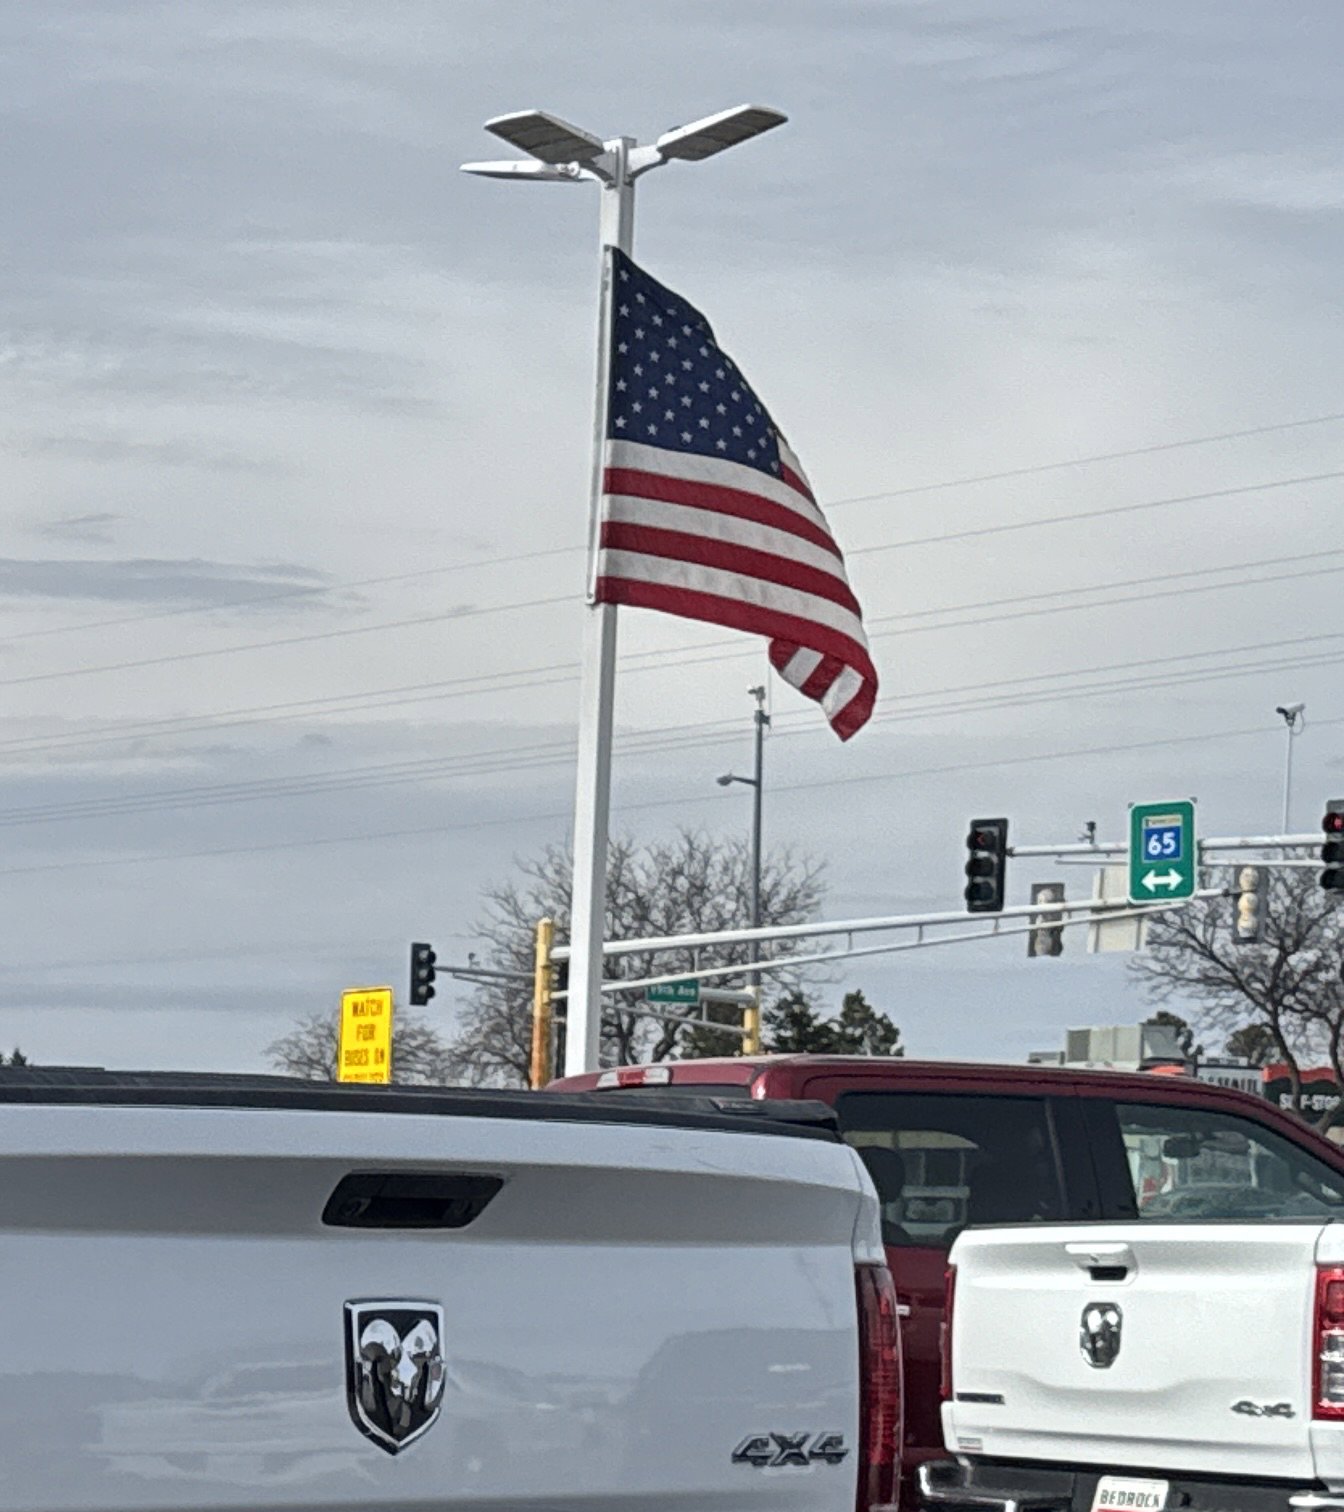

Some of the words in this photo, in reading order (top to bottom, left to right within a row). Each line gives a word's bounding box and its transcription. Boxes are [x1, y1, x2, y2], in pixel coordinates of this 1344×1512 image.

[1147, 831, 1177, 856] 65
[351, 998, 385, 1017] WATCH
[355, 1023, 377, 1042] FOR
[1099, 1488, 1161, 1508] BEDROCK
